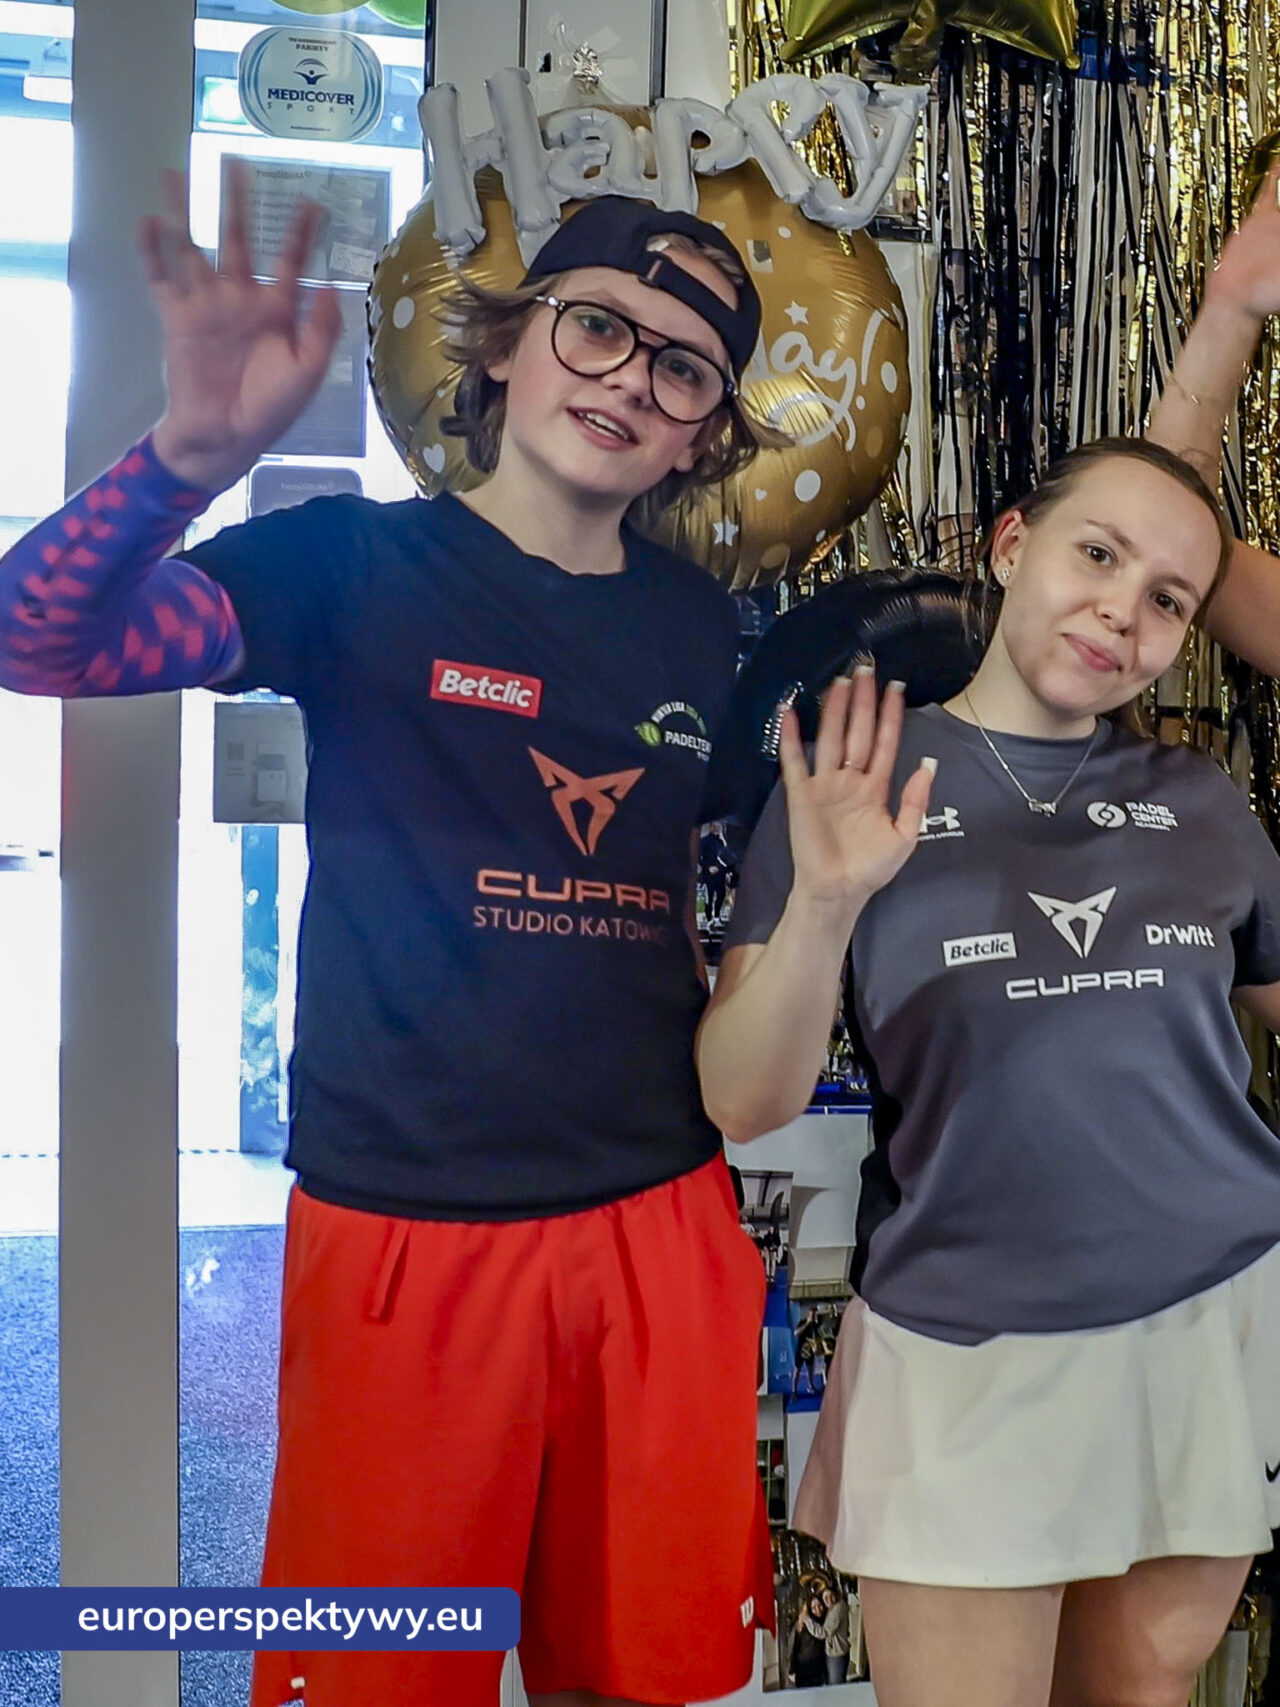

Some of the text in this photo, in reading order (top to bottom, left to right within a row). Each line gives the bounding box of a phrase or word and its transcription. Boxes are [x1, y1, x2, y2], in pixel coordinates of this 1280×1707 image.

[267, 88, 355, 105] MEDICOVER
[418, 66, 931, 262] Happy
[439, 668, 534, 708] Betclic
[1125, 802, 1175, 818] PADEL
[1131, 812, 1178, 827] CENTER
[476, 868, 671, 912] CUPRA
[473, 905, 574, 936] STUDIO
[949, 938, 1010, 960] Betclic
[1005, 968, 1165, 1000] CUPRA
